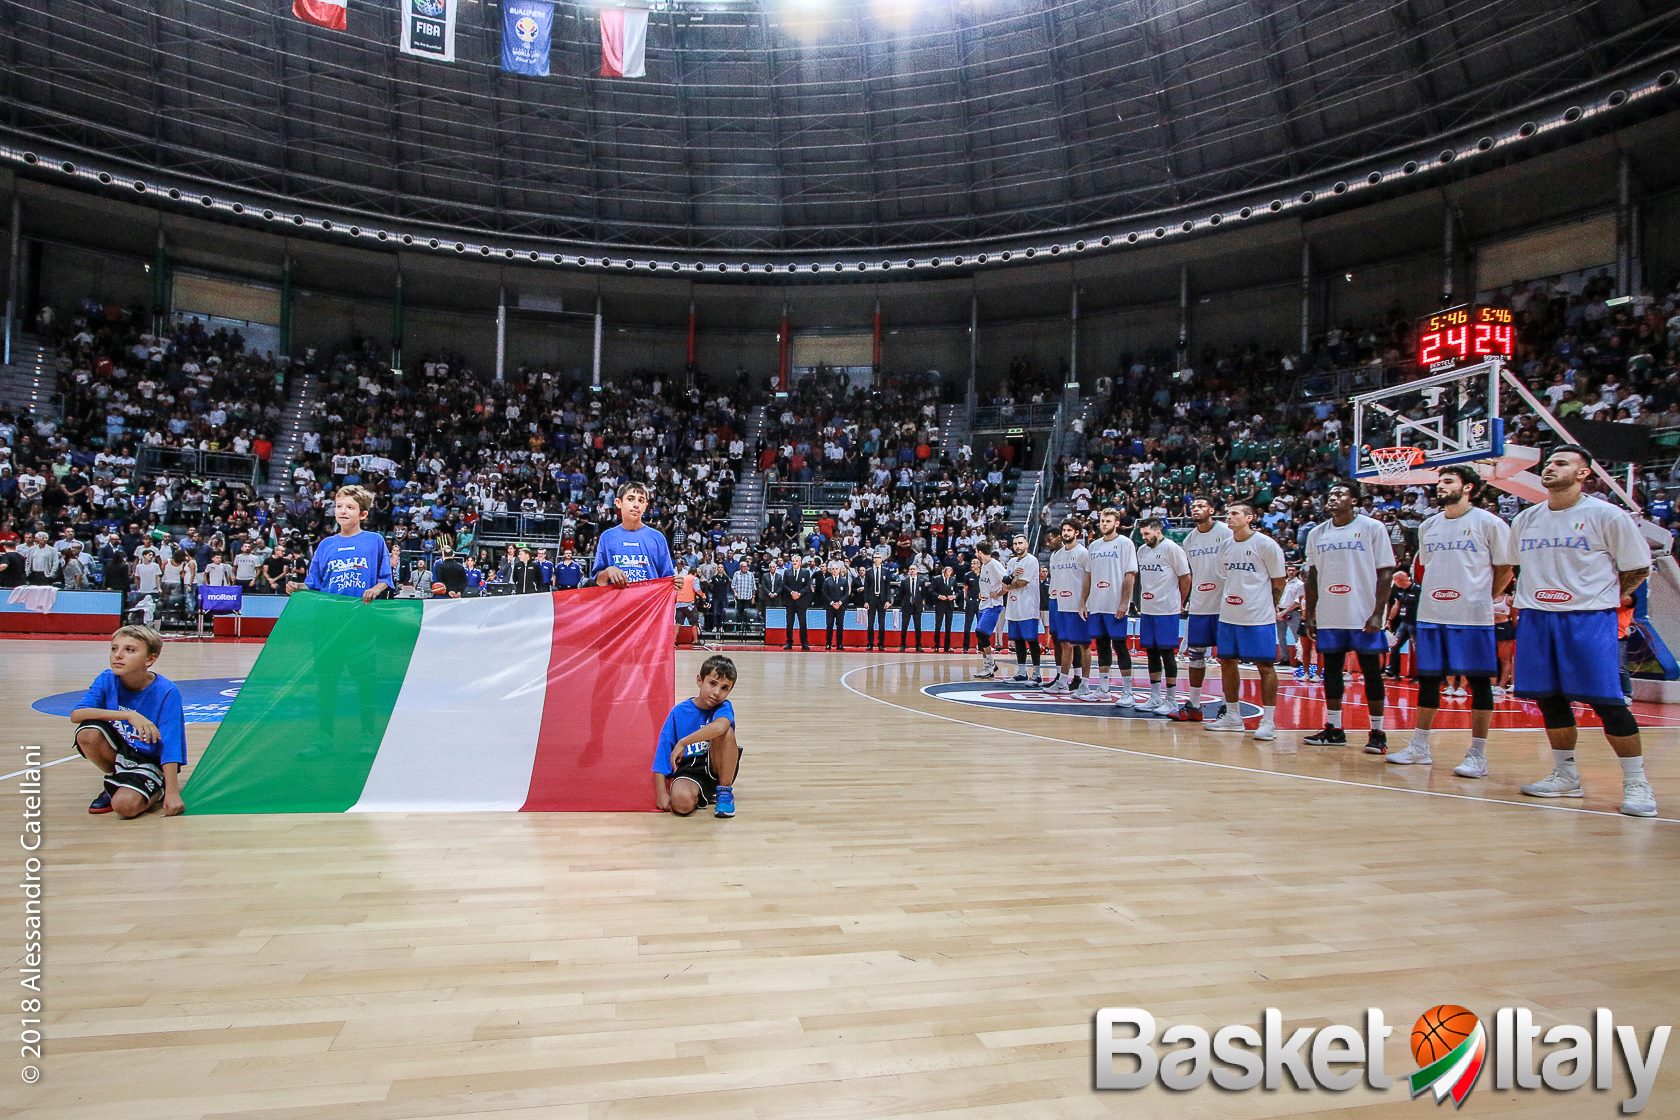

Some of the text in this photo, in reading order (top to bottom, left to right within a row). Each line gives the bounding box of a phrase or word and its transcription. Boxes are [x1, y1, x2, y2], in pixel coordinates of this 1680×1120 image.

[416, 21, 441, 37] FIBA
[1430, 311, 1467, 331] 5:46
[1482, 308, 1512, 322] 5:46
[1422, 326, 1467, 363] 24
[1475, 325, 1511, 354] 24
[1317, 540, 1365, 554] ITALIA
[1520, 536, 1591, 552] ITALIA
[1434, 590, 1460, 600] Barilla
[1536, 590, 1569, 601] Barilla
